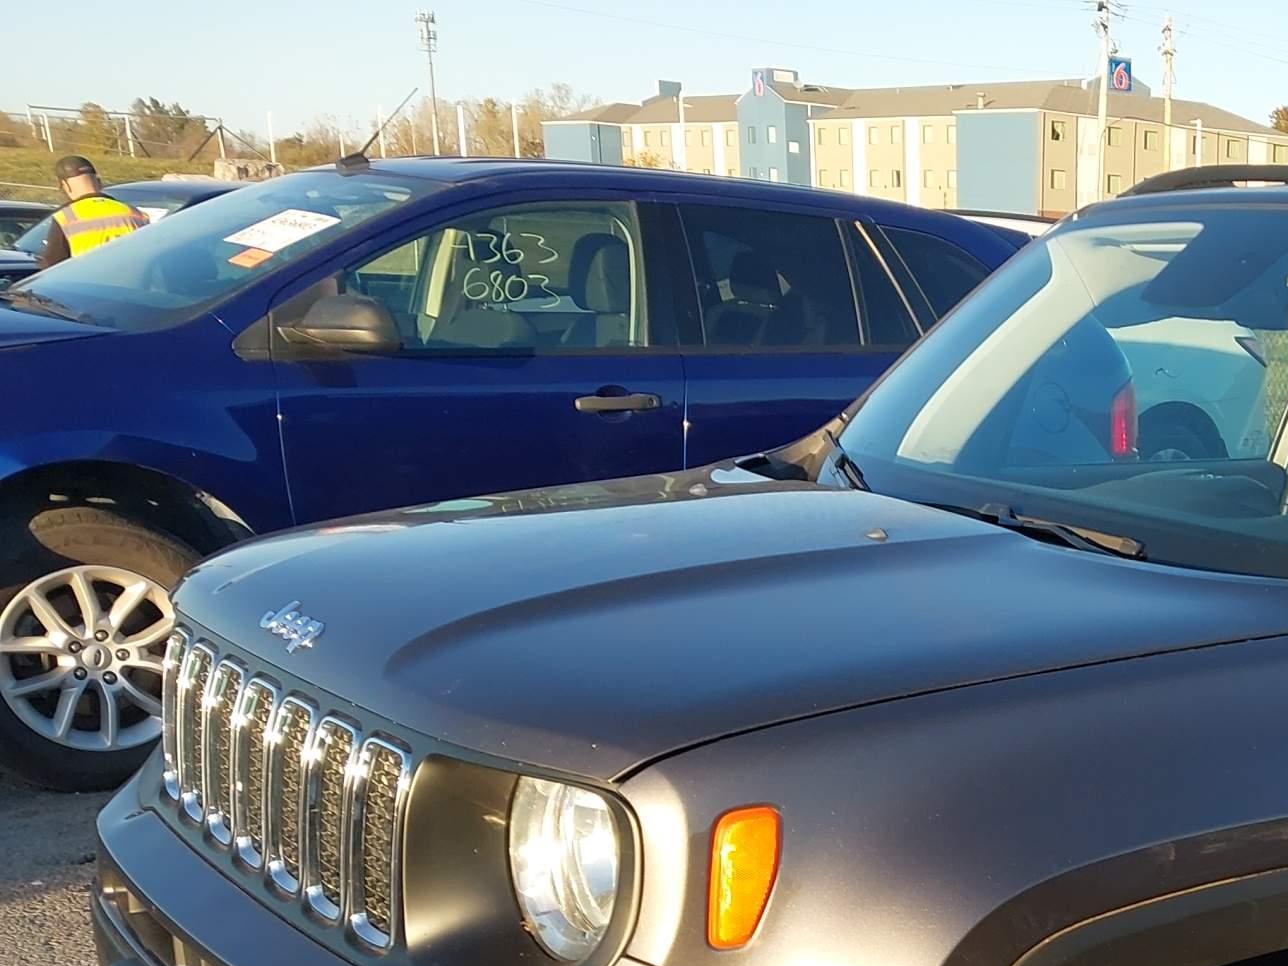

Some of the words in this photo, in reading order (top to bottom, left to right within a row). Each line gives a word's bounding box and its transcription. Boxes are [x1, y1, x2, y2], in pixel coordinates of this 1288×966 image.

[1113, 62, 1129, 90] 6
[463, 267, 561, 308] 6803
[259, 600, 325, 654] Jeep
